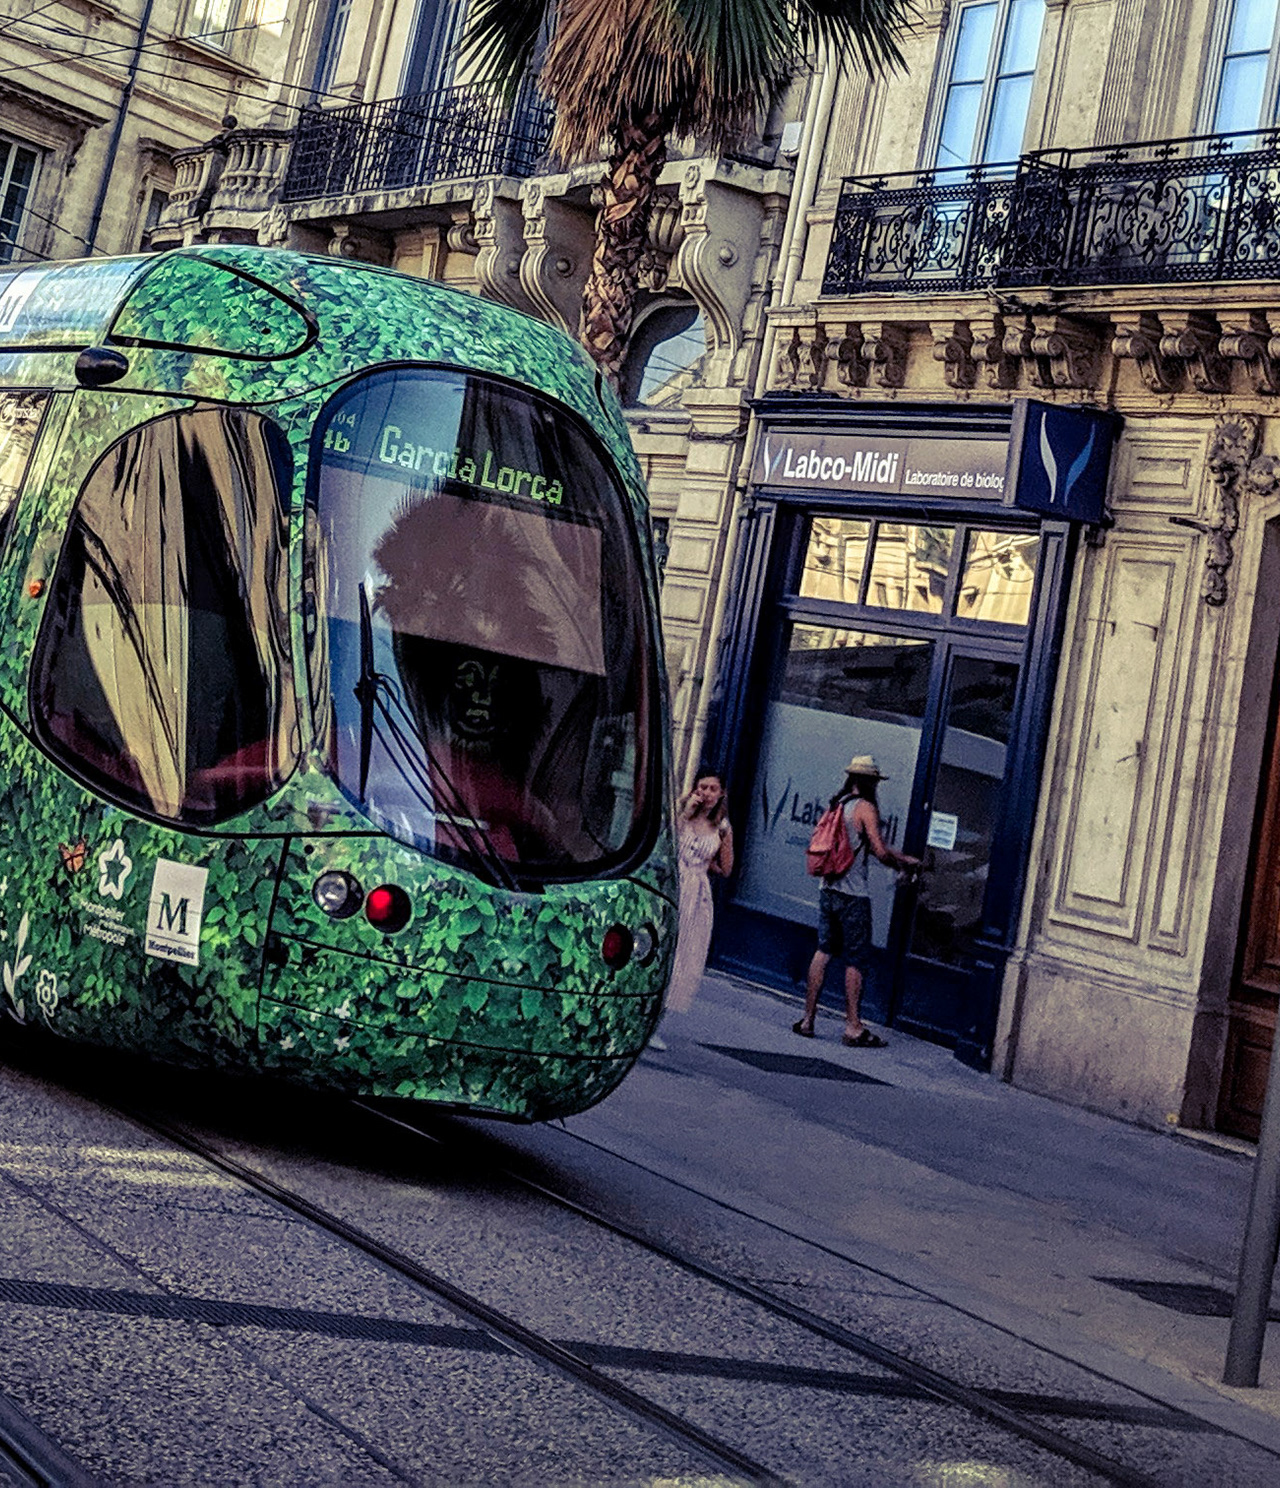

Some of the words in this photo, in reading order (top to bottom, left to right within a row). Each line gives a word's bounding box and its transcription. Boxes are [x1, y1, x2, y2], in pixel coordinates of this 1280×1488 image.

[379, 425, 476, 484] Garcia
[481, 450, 564, 505] Lorca
[783, 448, 900, 484] Labco-Midi
[905, 469, 960, 487] Laboratoire
[960, 472, 974, 488] de
[156, 892, 190, 936] M
